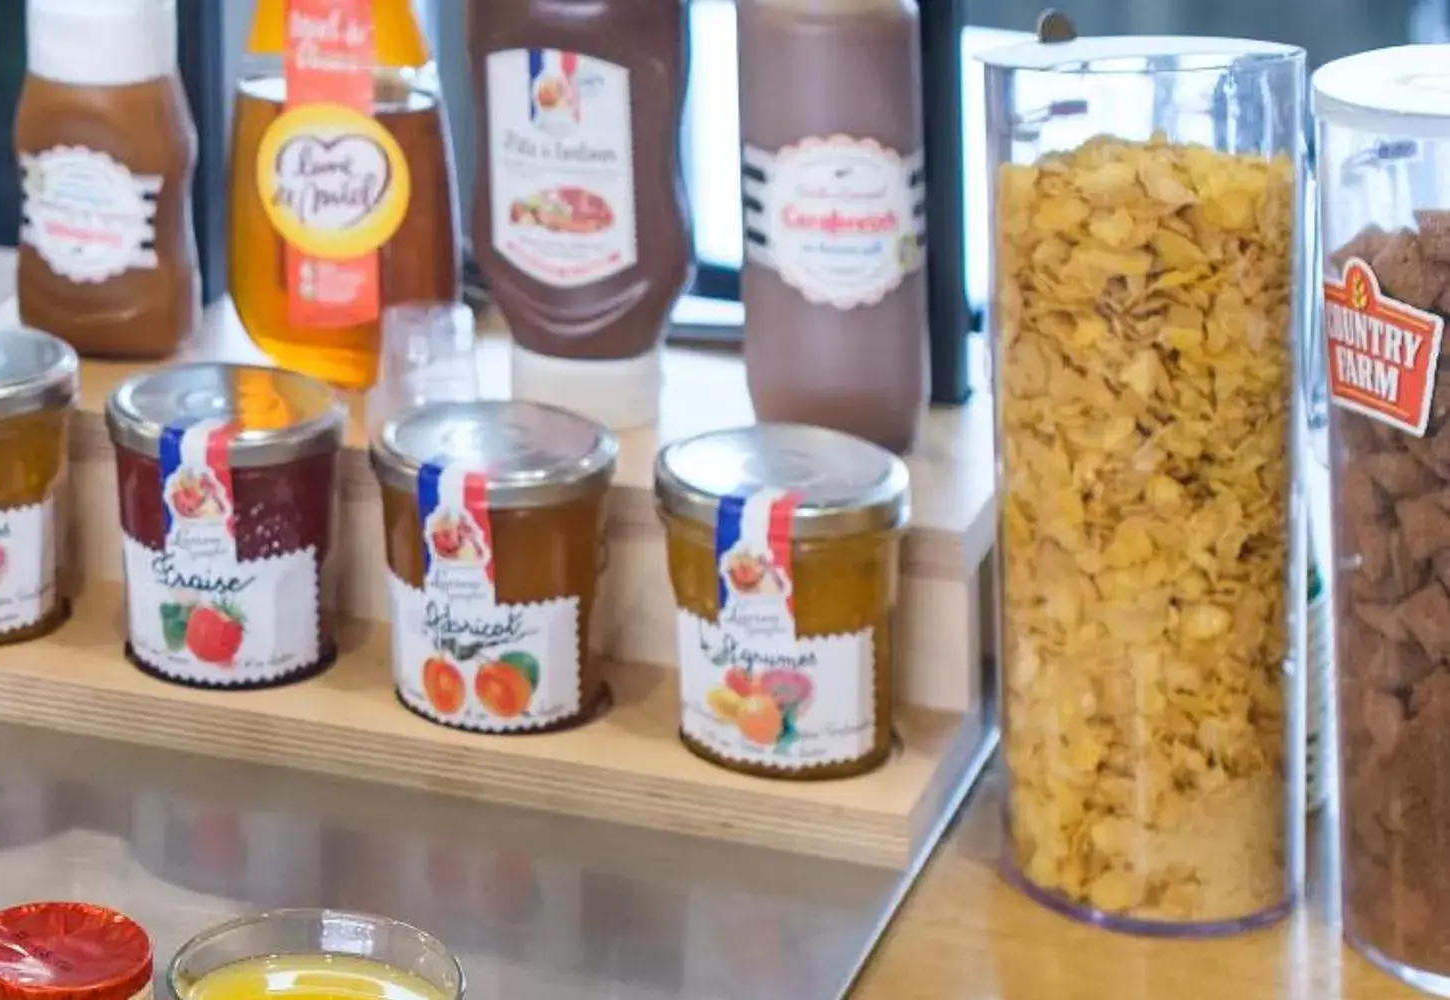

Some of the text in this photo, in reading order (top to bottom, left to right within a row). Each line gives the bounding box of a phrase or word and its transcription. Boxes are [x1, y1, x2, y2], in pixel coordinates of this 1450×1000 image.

[1335, 345, 1399, 403] FARM
[152, 551, 256, 593] Fraise
[424, 600, 525, 637] Abricot
[723, 633, 818, 678] Agrumes
